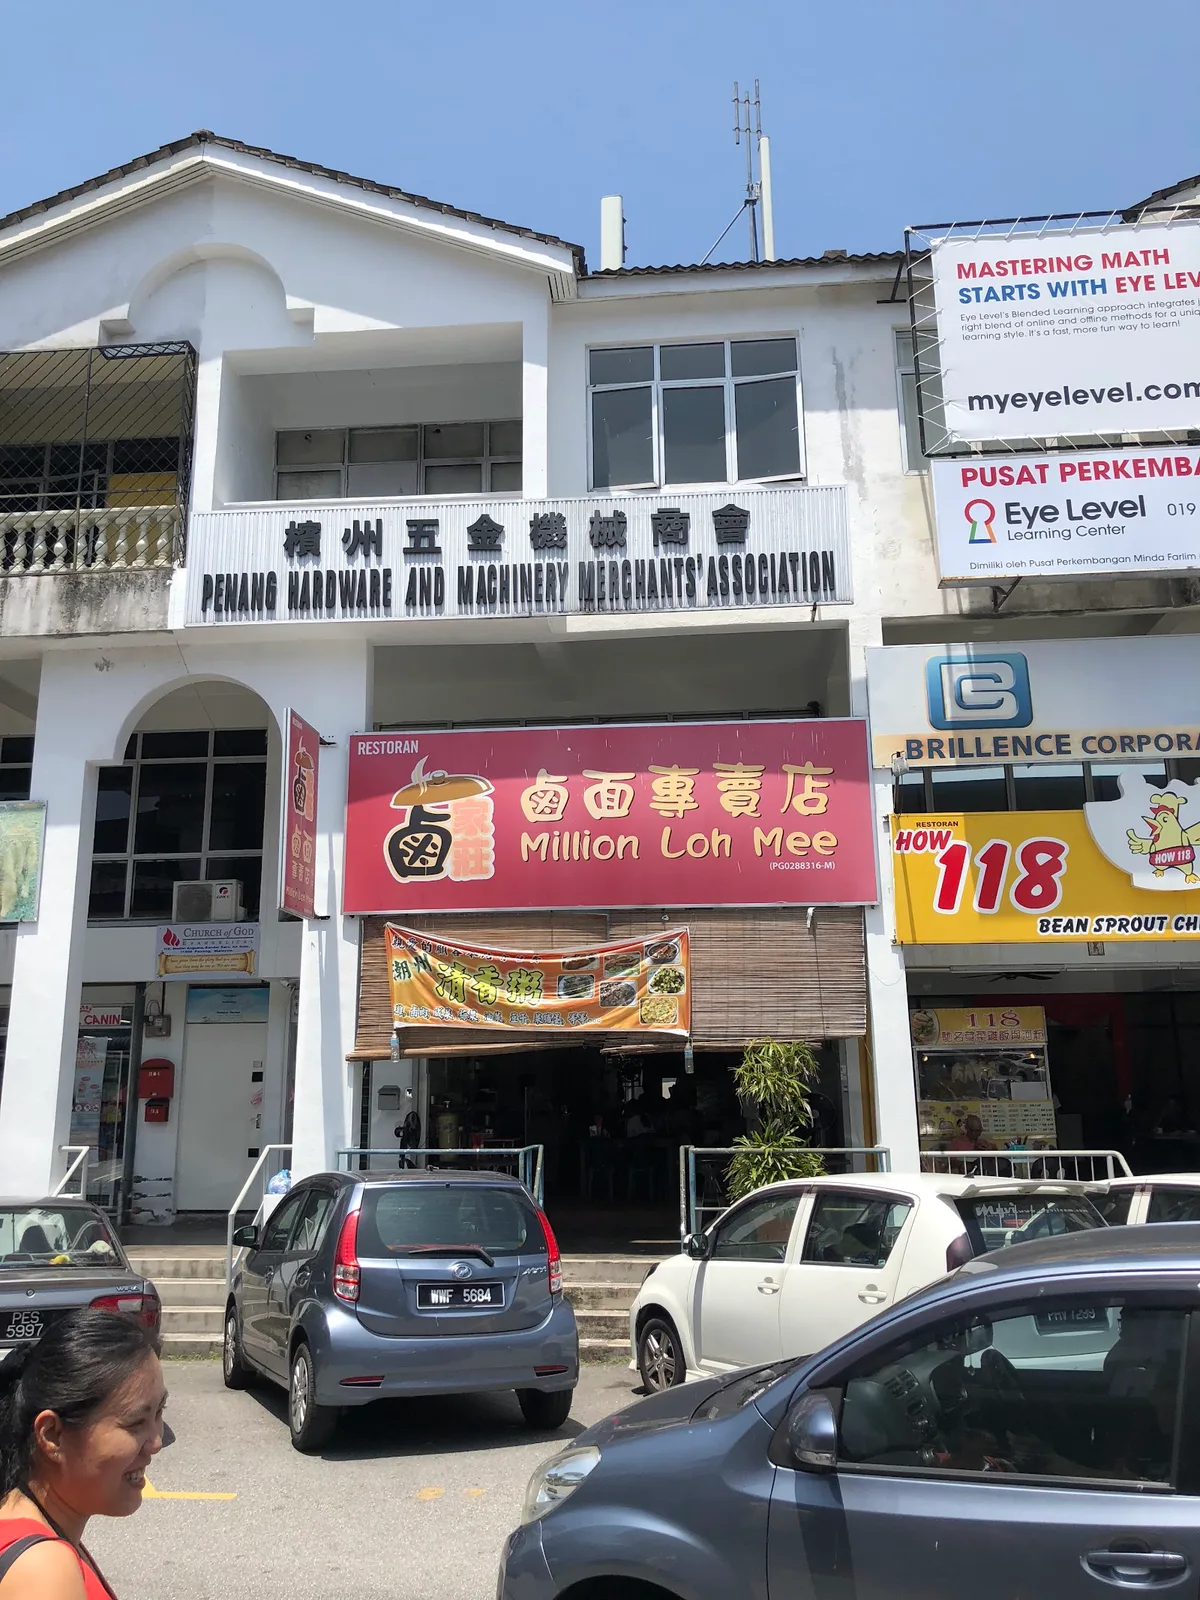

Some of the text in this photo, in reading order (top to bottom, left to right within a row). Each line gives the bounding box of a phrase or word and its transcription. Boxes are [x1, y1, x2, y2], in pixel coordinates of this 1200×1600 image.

[957, 248, 1170, 279] MASTERING MATH
[958, 283, 1041, 304] STARTS
[1047, 278, 1107, 298] WITH
[1115, 274, 1156, 294] EYE
[960, 313, 977, 322] Eye
[979, 311, 1009, 320] Level's
[1011, 308, 1051, 318] Blended
[1053, 304, 1094, 316] Learning
[1097, 301, 1146, 314] approach
[1148, 298, 1195, 309] integrates
[961, 323, 982, 333] right
[984, 321, 1012, 330] blend
[1014, 319, 1024, 328] of
[1026, 317, 1055, 327] online
[1057, 317, 1077, 325] and
[1080, 315, 1108, 324] offline
[1110, 311, 1153, 322] methods
[1154, 310, 1168, 319] for
[962, 332, 1001, 341] learning
[1003, 330, 1027, 340] style.
[1028, 329, 1041, 337] It's
[1052, 327, 1071, 336] fast,
[1073, 325, 1098, 334] more
[1100, 323, 1115, 332] fun
[1119, 322, 1138, 332] way
[1140, 321, 1150, 330] to
[1152, 319, 1181, 329] learn!
[961, 464, 1049, 488] PUSAT
[1004, 495, 1197, 529] Eye Level 019
[1007, 524, 1126, 541] Learning Center
[970, 551, 1196, 570] Dimiliki oleh Pusat Perkembangan Minda Farlim
[201, 571, 277, 613] PENANG
[287, 568, 392, 609] HARDWARE
[405, 566, 445, 606] AND
[457, 562, 569, 605] MACHINERY
[706, 551, 835, 597] ASSOCIATION
[357, 740, 419, 755] RESTORAN
[905, 733, 1200, 760] BRILLENCE CORPOR
[916, 820, 959, 828] RESTORAN
[520, 826, 839, 862] Million Loh Mee
[896, 830, 952, 851] HOW
[770, 861, 836, 872] (PG0288316-M)
[1154, 849, 1191, 864] HOW 118
[937, 840, 1066, 911] 118
[183, 926, 254, 938] CHURCH of GOD
[1038, 917, 1089, 933] BEAN
[1092, 915, 1167, 934] SPROUT
[965, 1011, 1020, 1028] 118
[430, 1287, 492, 1304] WWF 5684
[12, 1310, 40, 1325] PES
[6, 1323, 44, 1338] 5997
